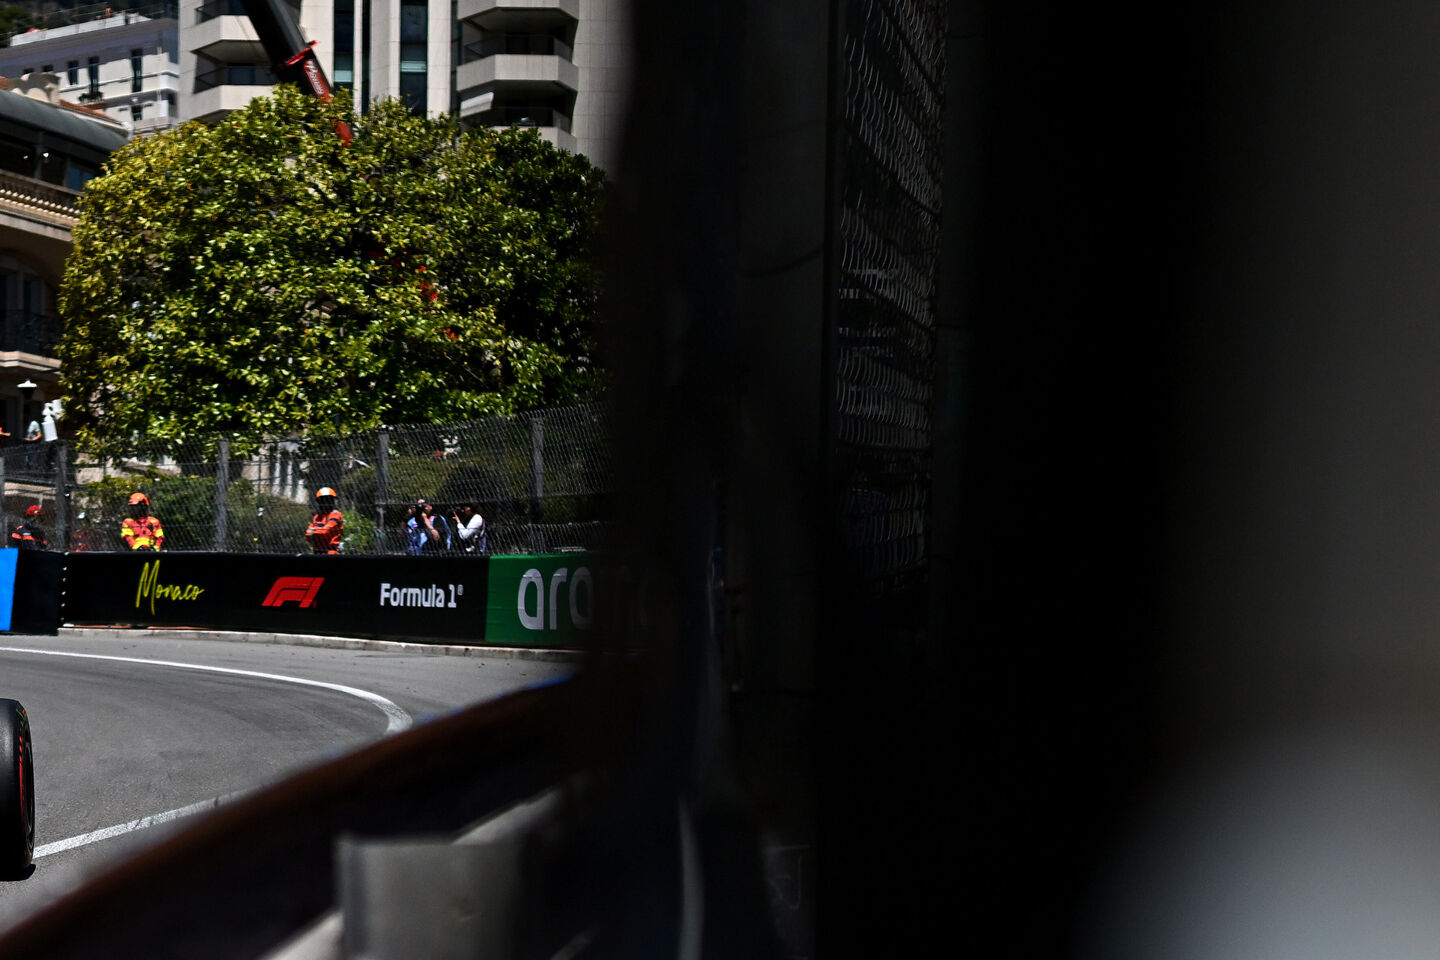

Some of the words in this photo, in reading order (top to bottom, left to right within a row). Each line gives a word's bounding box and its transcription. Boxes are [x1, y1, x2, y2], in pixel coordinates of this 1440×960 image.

[135, 559, 205, 616] Monaco
[380, 583, 445, 608] Formula
[517, 566, 596, 630] ara
